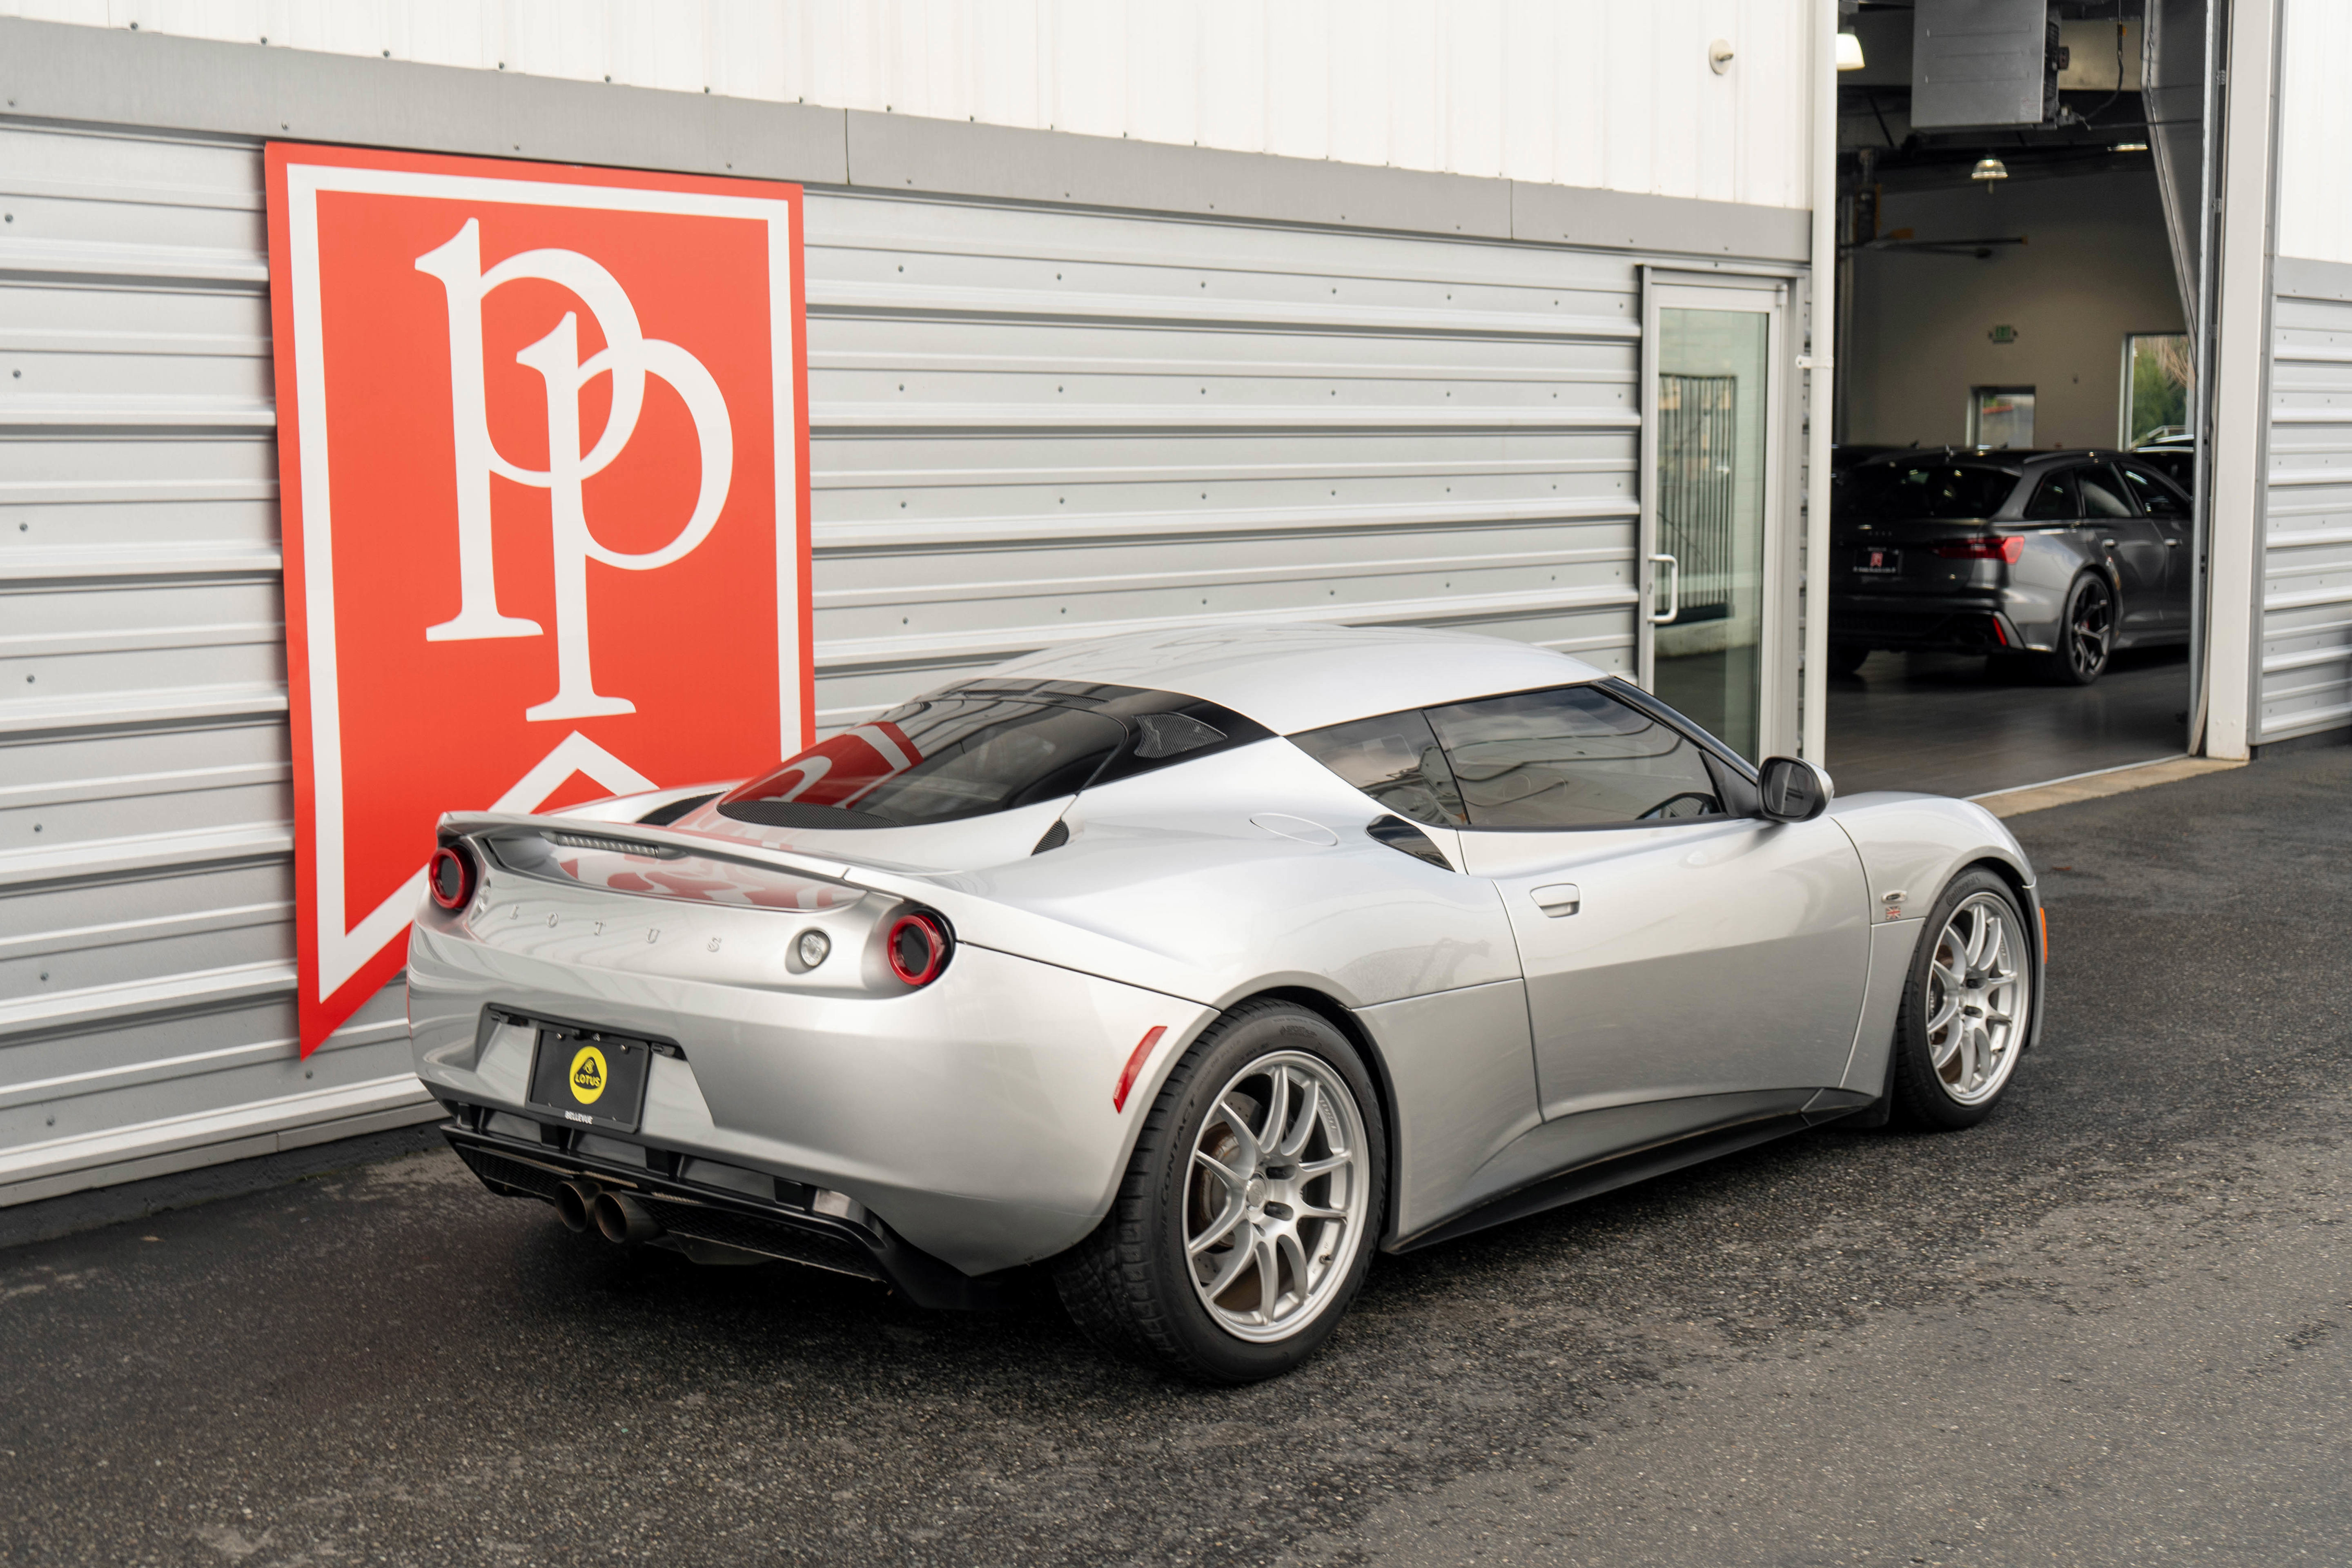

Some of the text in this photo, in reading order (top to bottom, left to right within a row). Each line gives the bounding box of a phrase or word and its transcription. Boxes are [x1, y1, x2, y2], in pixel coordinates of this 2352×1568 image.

[510, 904, 722, 952] LOTUS
[575, 1074, 601, 1087] LOTUS
[565, 1111, 593, 1124] BELLEVUE
